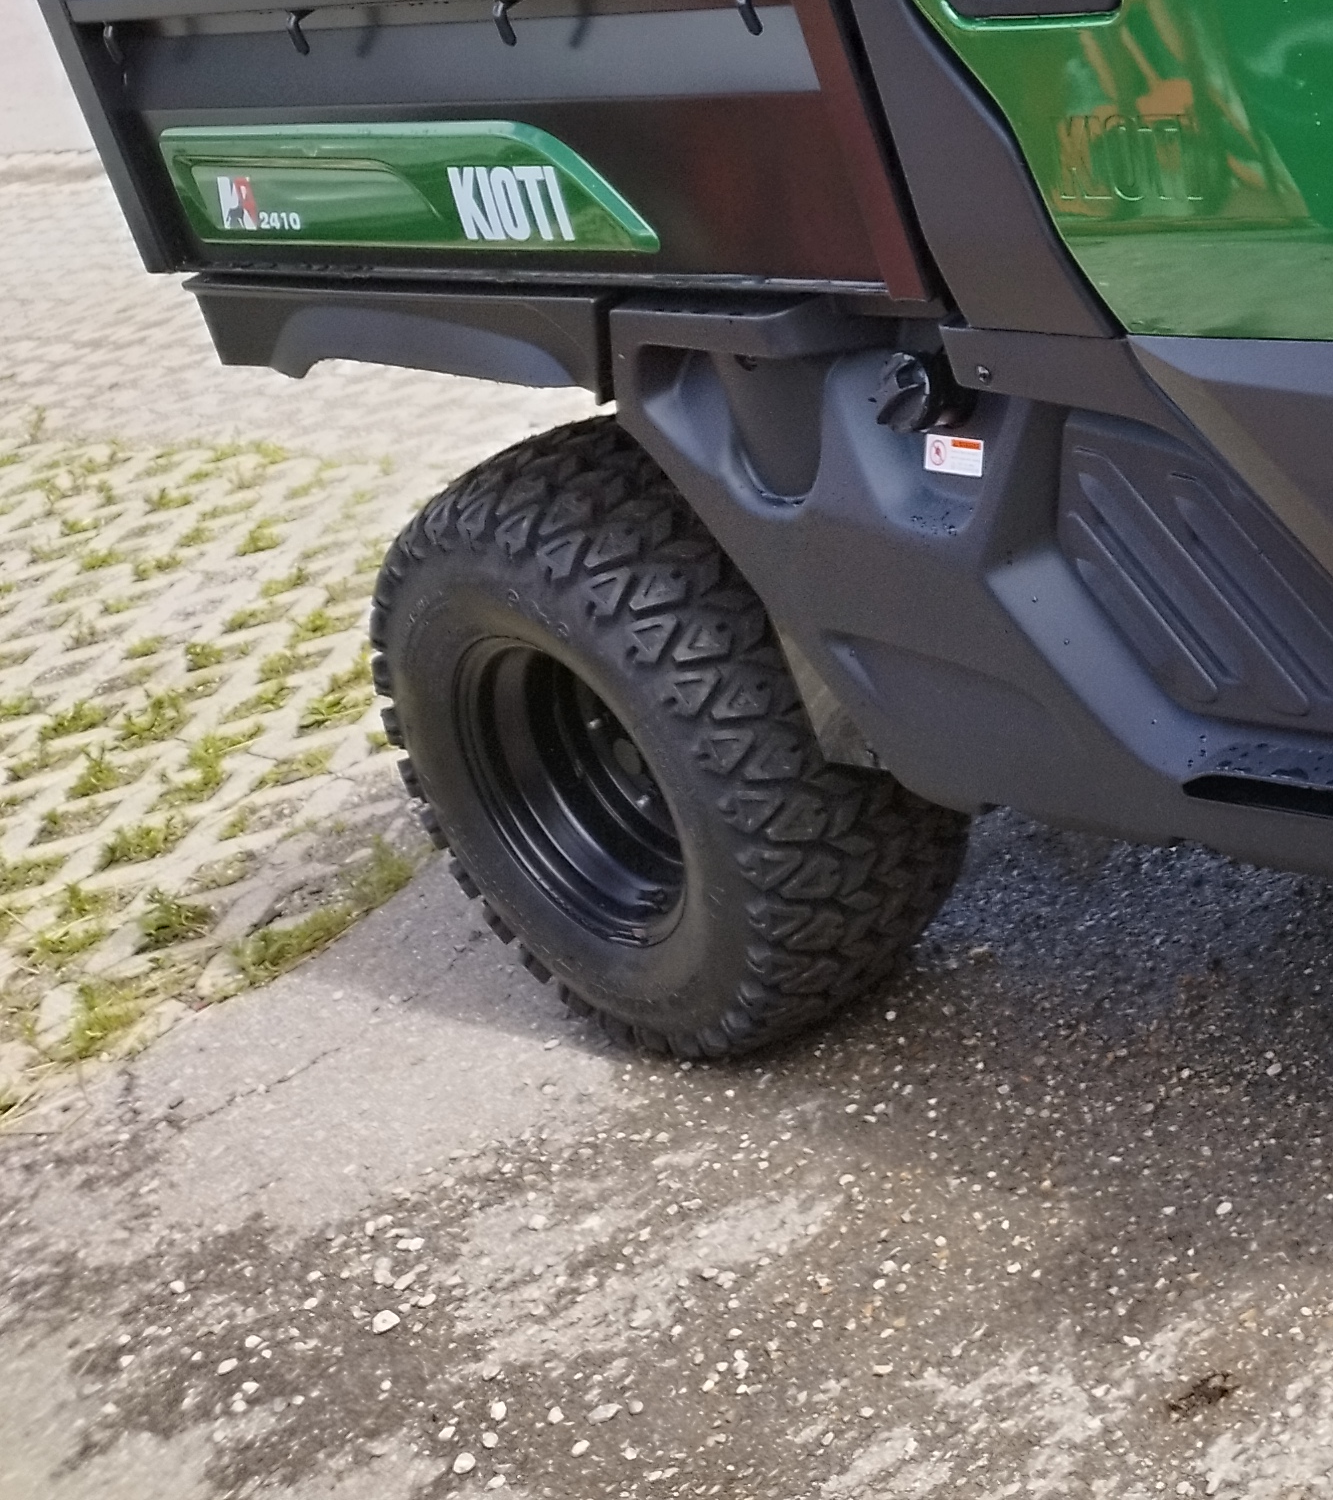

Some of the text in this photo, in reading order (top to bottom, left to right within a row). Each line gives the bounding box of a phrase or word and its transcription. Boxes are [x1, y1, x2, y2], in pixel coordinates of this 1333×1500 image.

[1052, 114, 1204, 201] KIOTI
[259, 211, 301, 231] 2410
[447, 165, 576, 241] KIOTI
